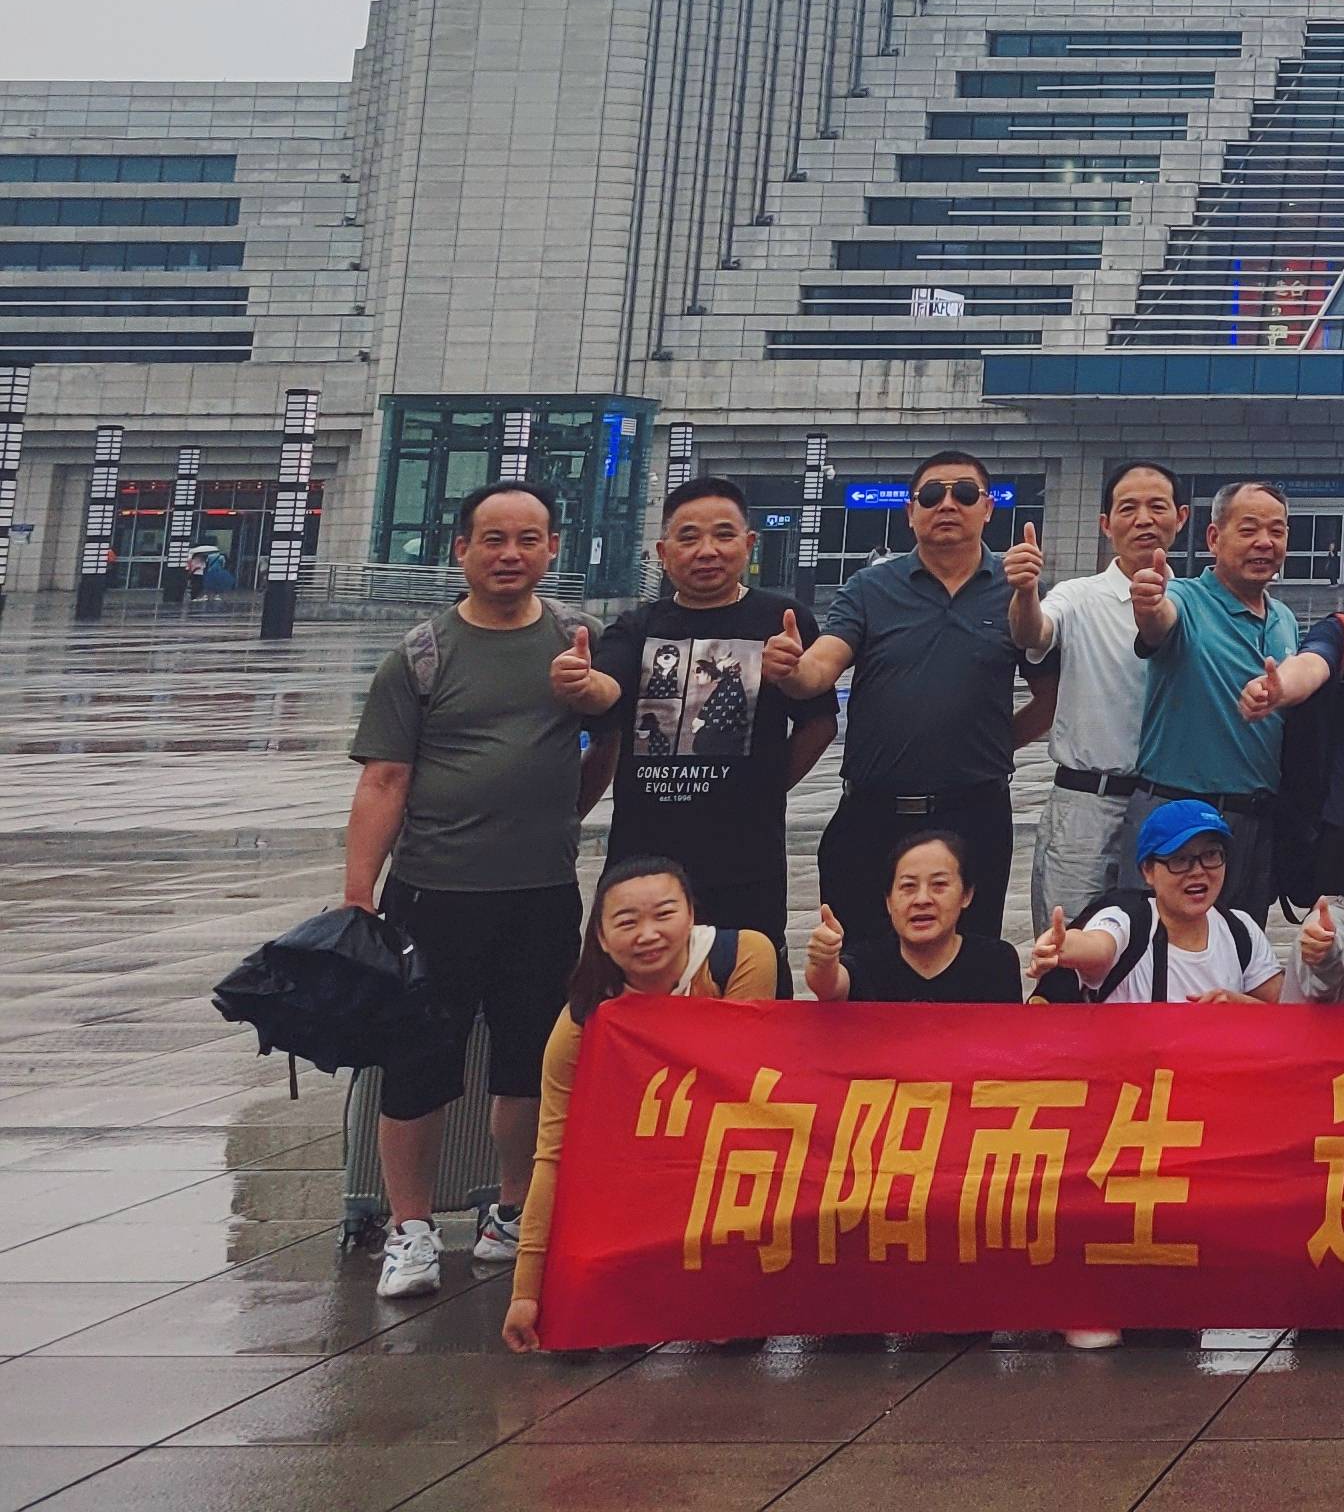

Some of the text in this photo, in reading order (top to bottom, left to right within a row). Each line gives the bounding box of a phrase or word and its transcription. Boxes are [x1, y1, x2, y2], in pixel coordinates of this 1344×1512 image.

[637, 766, 730, 779] CONSTANTLY
[645, 782, 710, 793] EVOLVING
[634, 1067, 1206, 1273] “向阳而生
